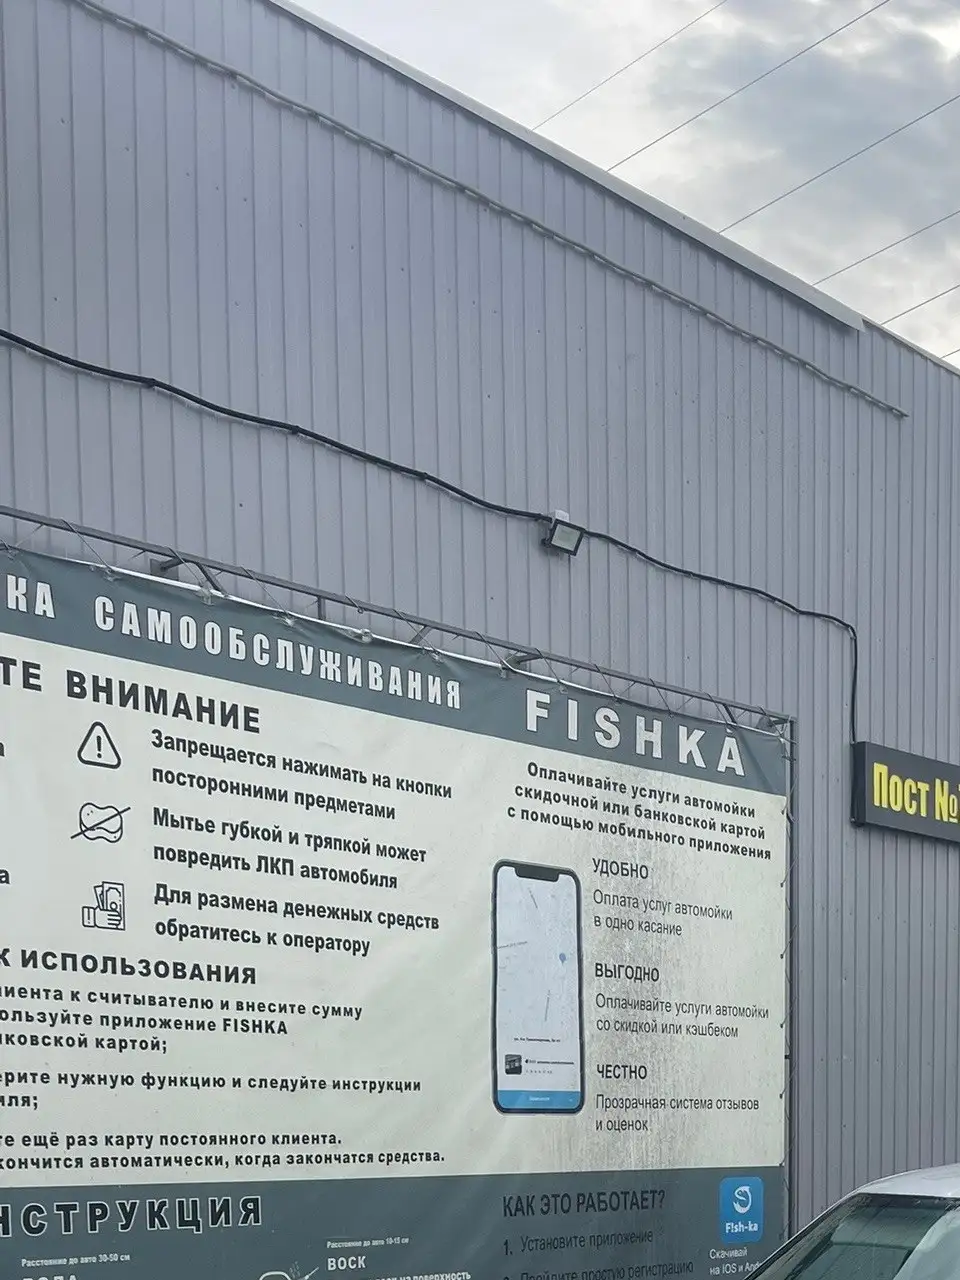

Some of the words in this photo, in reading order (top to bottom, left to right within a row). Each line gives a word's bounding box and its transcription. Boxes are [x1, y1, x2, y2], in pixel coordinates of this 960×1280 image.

[7, 574, 55, 618] КА
[95, 596, 461, 709] САМООБСЛУЖИВАНИЯ
[0, 656, 42, 691] ТЕ
[67, 669, 261, 734] ВНИМАНИЕ
[526, 690, 745, 776] FISHKA
[152, 729, 276, 768] Запрещается
[283, 758, 367, 784] нажимать
[373, 774, 390, 788] на
[397, 778, 451, 798] кнопки
[153, 768, 288, 802] посторонними
[295, 792, 395, 819] предметами
[528, 762, 626, 793] Оплачивайте
[632, 786, 679, 803] услуги
[684, 796, 754, 817] автомойки
[873, 762, 930, 818] Пост
[515, 786, 598, 810] скидочной
[603, 802, 629, 815] или
[634, 804, 716, 831] банковской
[721, 823, 764, 839] картой
[154, 807, 215, 833] Мытье
[222, 821, 282, 843] губкой
[289, 832, 298, 845] и
[305, 834, 370, 855] тряпкой
[376, 844, 426, 862] может
[508, 807, 515, 817] с
[521, 809, 593, 830] помощью
[599, 823, 684, 845] мобильного
[690, 838, 770, 859] приложения
[154, 846, 250, 870] повредить
[256, 855, 294, 876] ЛКП
[301, 865, 397, 888] автомобиля
[592, 858, 649, 880] УДОБНО
[154, 884, 191, 905] Для
[198, 893, 277, 913] размена
[283, 902, 372, 923] денежных
[378, 912, 439, 930] средств
[594, 889, 640, 909] Оплата
[643, 899, 671, 916] услуг
[675, 903, 732, 920] автомойки
[156, 918, 261, 943] обратитесь
[267, 932, 277, 945] к
[283, 934, 370, 957] оператору
[594, 916, 601, 926] в
[606, 917, 634, 931] одно
[638, 921, 682, 936] касание
[21, 950, 255, 984] ИСПОЛЬЗОВАНИЯ
[595, 962, 660, 982] ВЫГОДНО
[71, 991, 80, 1002] к
[88, 992, 213, 1009] считывателю
[221, 1000, 229, 1010] и
[236, 1001, 305, 1014] внесите
[313, 1005, 362, 1020] сумму
[596, 993, 671, 1012] Оплачивайте
[675, 1002, 711, 1017] услуги
[716, 1005, 768, 1018] автомойки
[100, 1015, 216, 1031] приложение
[223, 1018, 287, 1034] FISHKA
[597, 1019, 610, 1031] со
[614, 1019, 657, 1034] скидкой
[662, 1023, 682, 1034] или
[686, 1023, 738, 1037] кэшбеком
[96, 1037, 166, 1054] картой;
[58, 1074, 134, 1089] нужную
[142, 1072, 225, 1090] функцию
[233, 1078, 241, 1088] и
[248, 1076, 326, 1092] следуйте
[333, 1080, 420, 1093] инструкции
[597, 1064, 647, 1080] ЧЕСТНО
[596, 1094, 668, 1112] Прозрачная
[670, 1099, 712, 1109] система
[716, 1099, 759, 1110] отзывов
[596, 1120, 602, 1130] и
[607, 1117, 648, 1133] оценок
[22, 1132, 59, 1149] ещё
[66, 1135, 98, 1150] раз
[105, 1135, 153, 1149] карту
[160, 1135, 265, 1145] постоянного
[272, 1134, 341, 1144] клиента.
[90, 1156, 228, 1168] автоматически,
[236, 1155, 280, 1167] когда
[287, 1154, 373, 1164] закончатся
[379, 1152, 444, 1165] средства.
[503, 1195, 535, 1217] КАК
[540, 1193, 571, 1215] ЭТО
[576, 1189, 666, 1213] РАБОТАЕТ?
[503, 1240, 513, 1255] 1.
[520, 1234, 585, 1252] Установите
[589, 1230, 653, 1247] приложение
[710, 1247, 748, 1259] Скачивай
[327, 1256, 366, 1271] ВОСК
[628, 1260, 694, 1280] регистрацию
[710, 1266, 720, 1275] на
